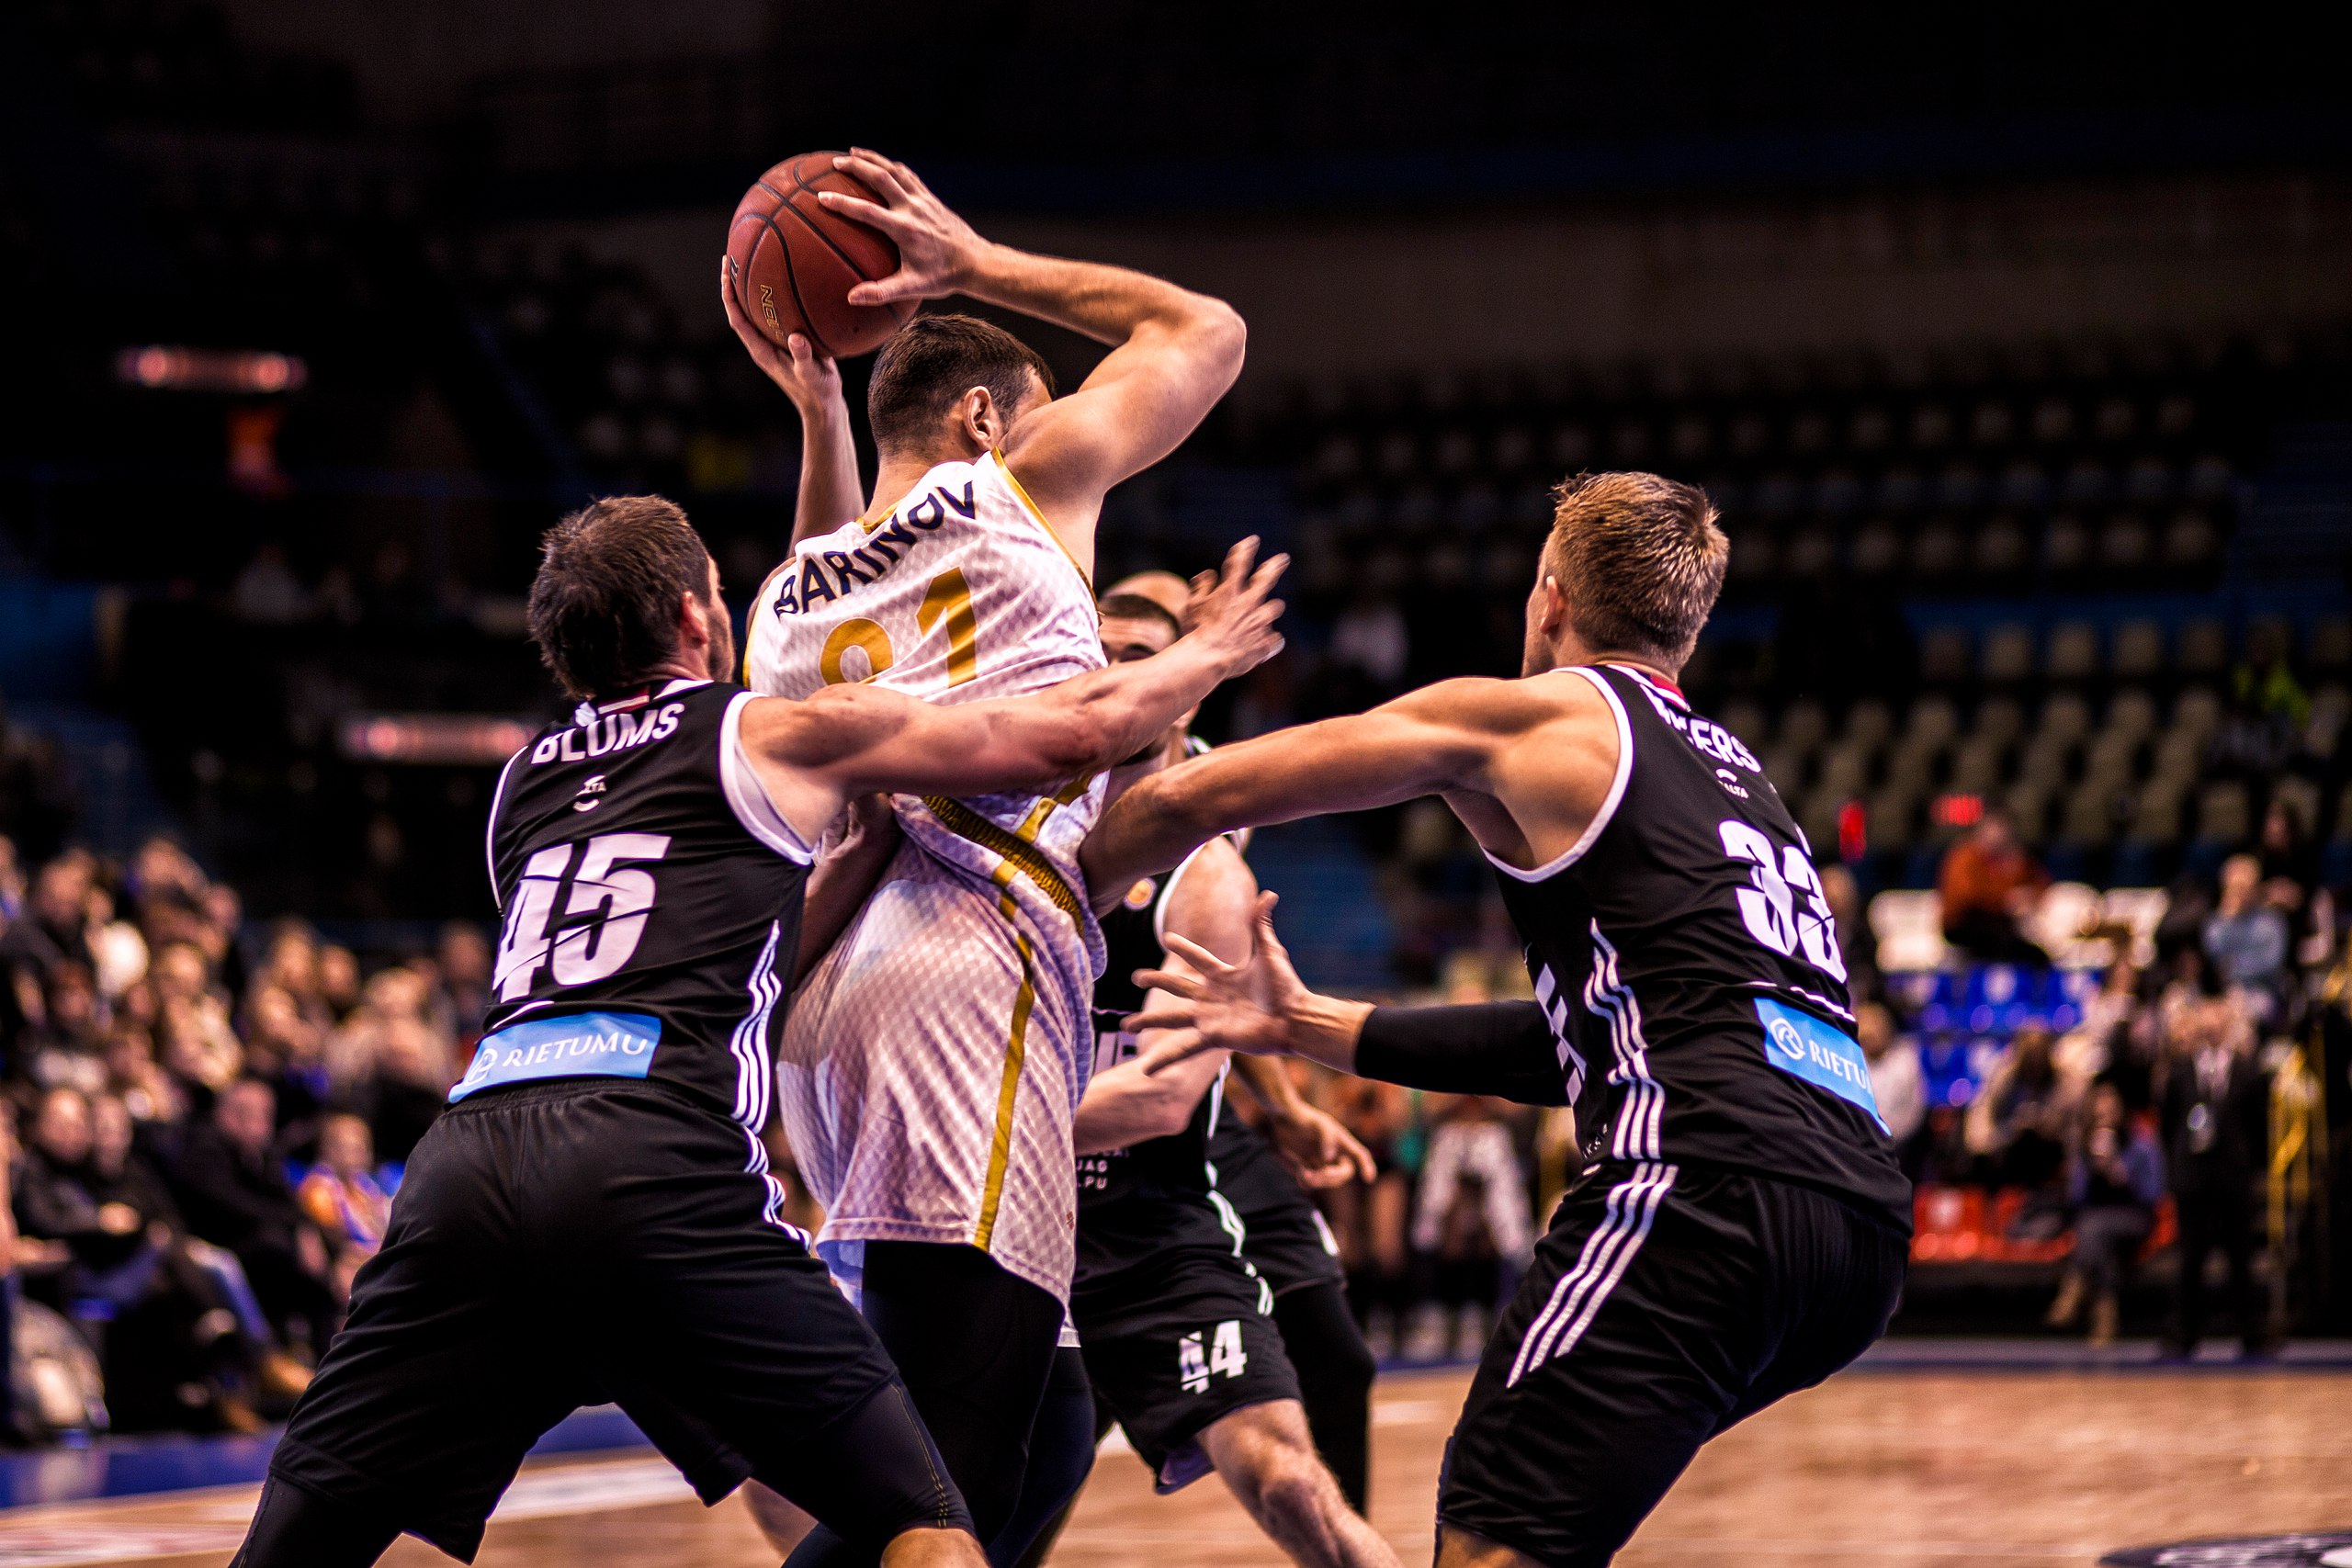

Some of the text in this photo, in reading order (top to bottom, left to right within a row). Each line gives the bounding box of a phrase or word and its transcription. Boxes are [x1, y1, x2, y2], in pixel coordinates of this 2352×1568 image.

[772, 479, 978, 619] BARINOV
[530, 702, 686, 765] BLUMS
[492, 831, 673, 1004] 45
[502, 1032, 649, 1068] RIETUMU
[1808, 1039, 1872, 1095] RIETU
